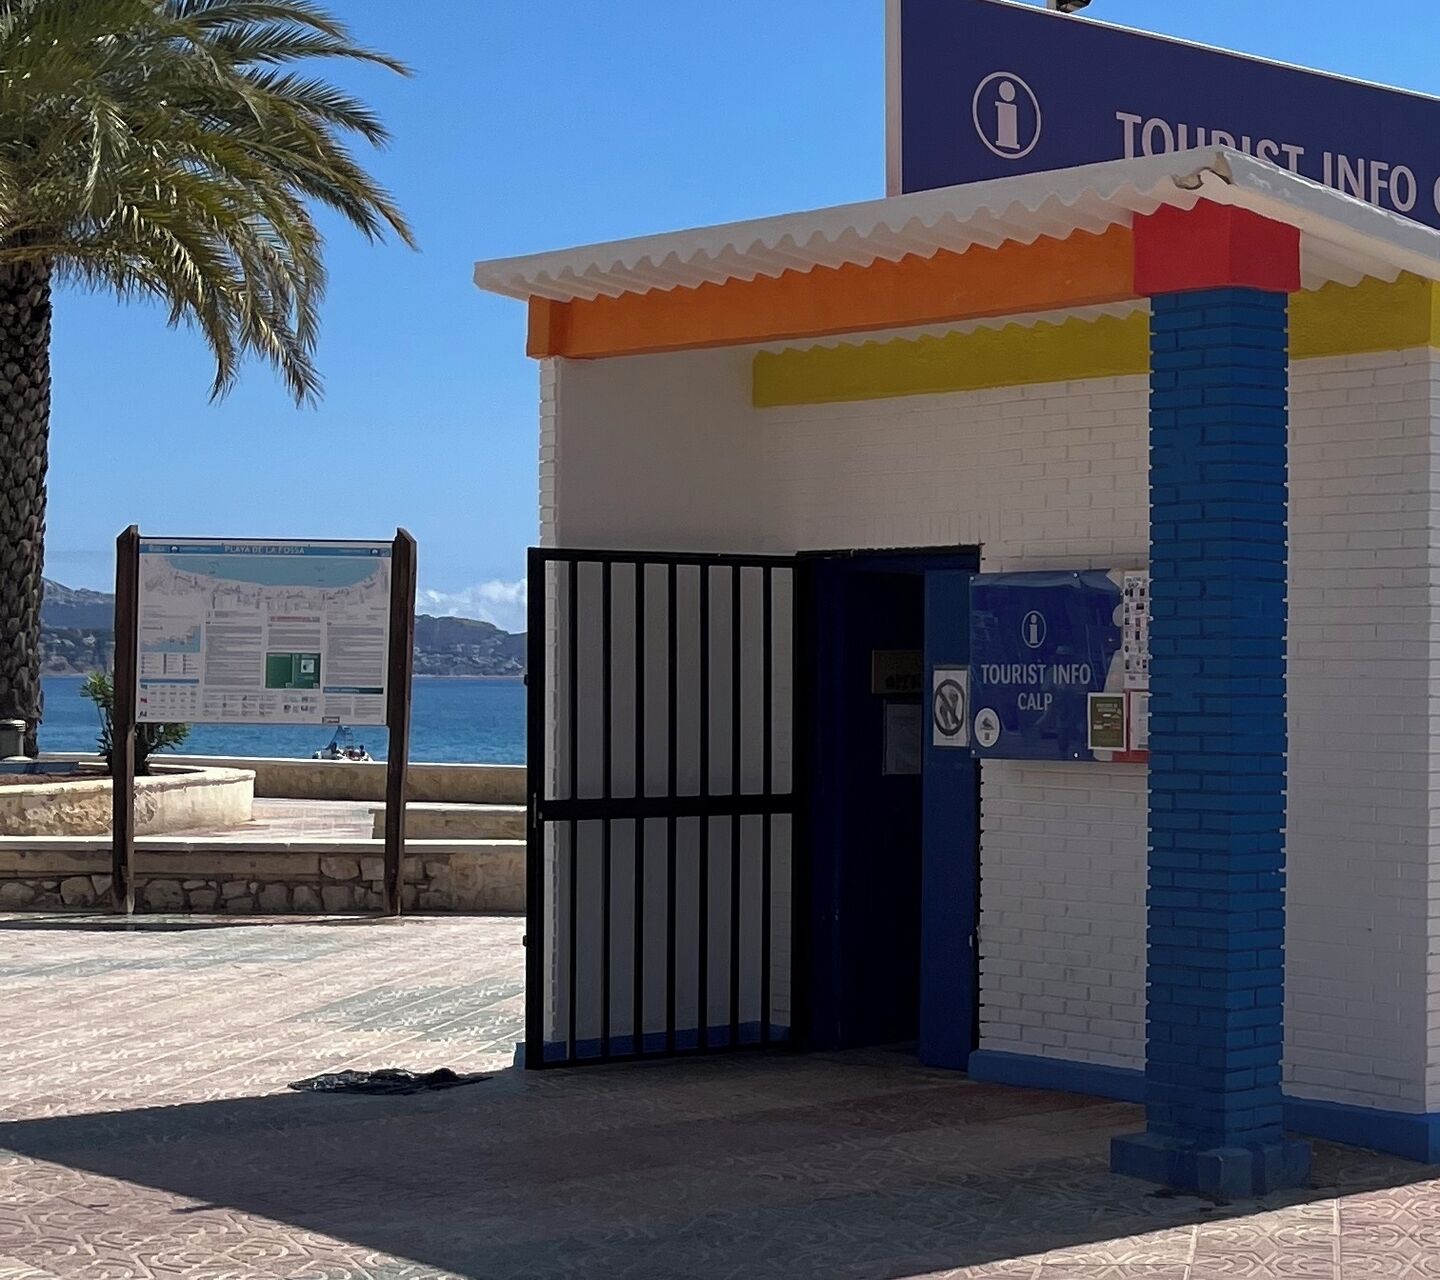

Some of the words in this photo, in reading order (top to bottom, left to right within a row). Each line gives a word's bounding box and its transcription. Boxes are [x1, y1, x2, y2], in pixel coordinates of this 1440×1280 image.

[1323, 151, 1417, 212] INFO
[224, 545, 250, 553] PLAYA
[981, 664, 1046, 685] TOURIST
[1053, 664, 1092, 685] INFO
[1017, 693, 1053, 712] CALP
